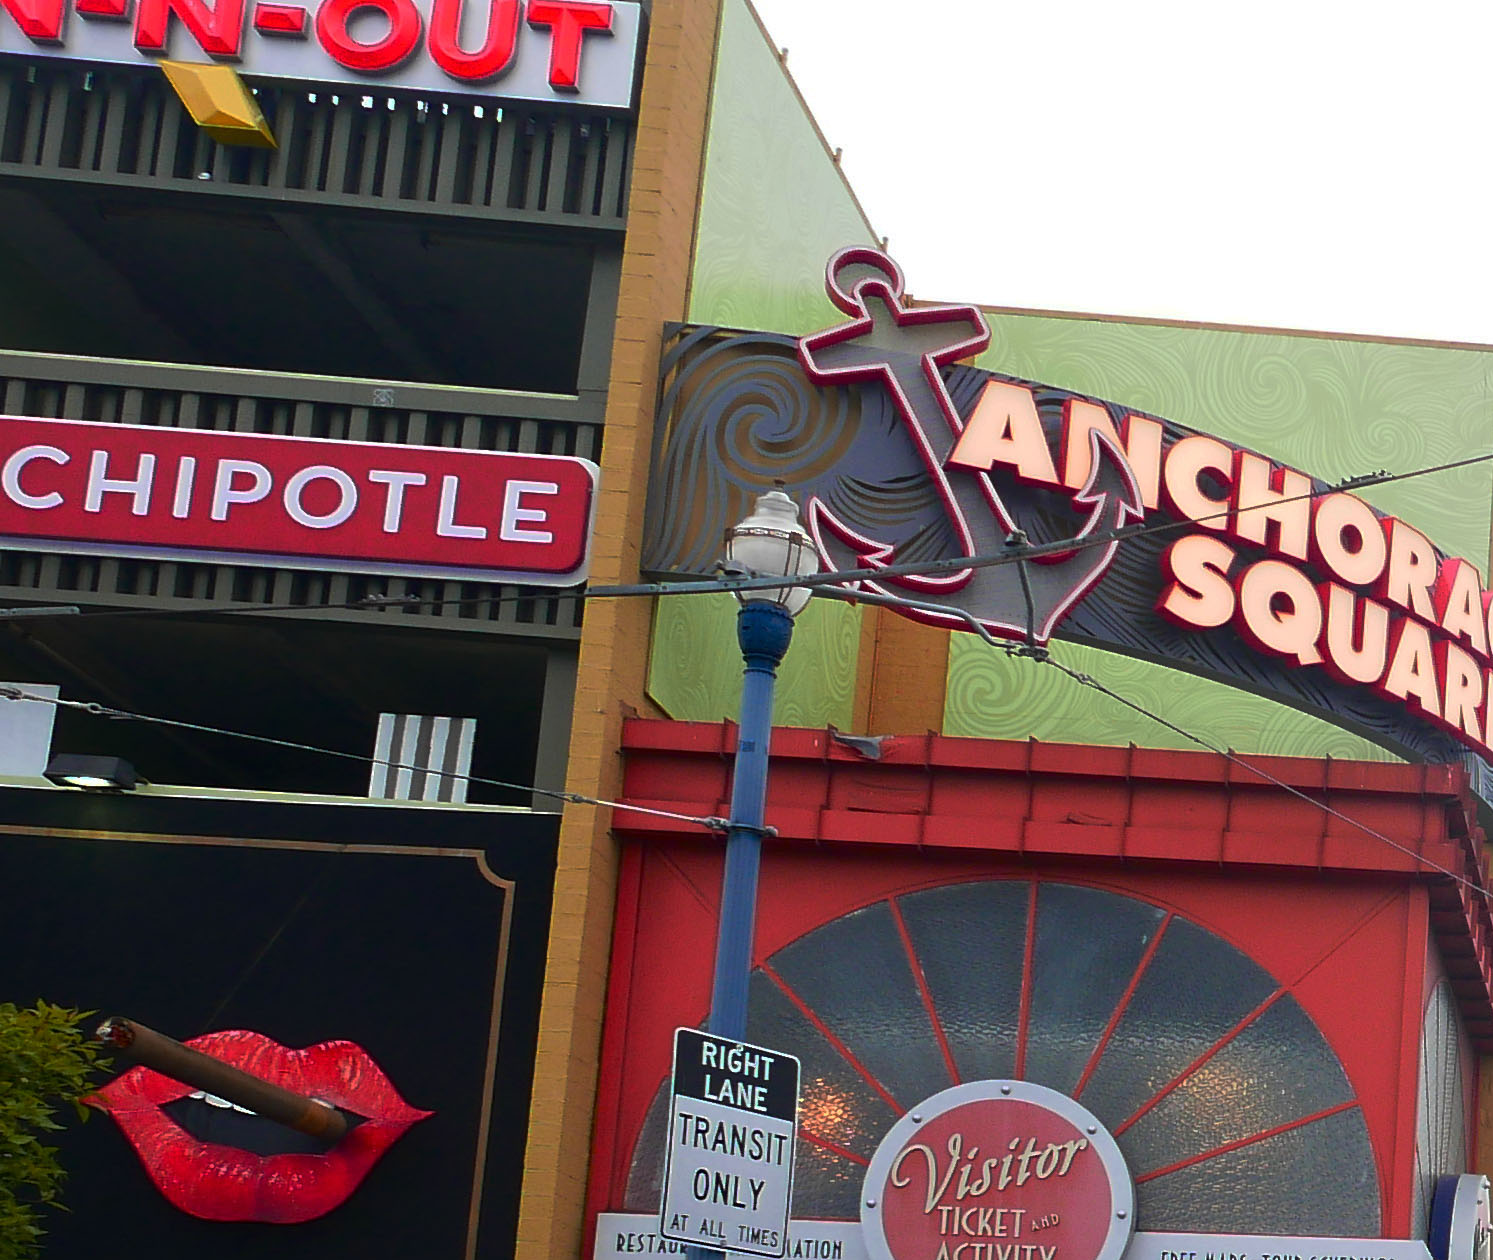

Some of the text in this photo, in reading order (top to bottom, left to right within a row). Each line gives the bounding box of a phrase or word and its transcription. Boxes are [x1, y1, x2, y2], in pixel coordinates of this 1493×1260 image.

[1, 443, 563, 547] CHIPOTLE
[701, 1040, 775, 1082] RIGHT
[703, 1074, 769, 1113] LANE
[678, 1112, 788, 1166] TRANSIT
[693, 1167, 766, 1212] ONLY
[891, 1133, 1089, 1214] Visitor
[669, 1213, 780, 1249] AT ALL TIMES
[937, 1206, 1061, 1238] TICKET AND
